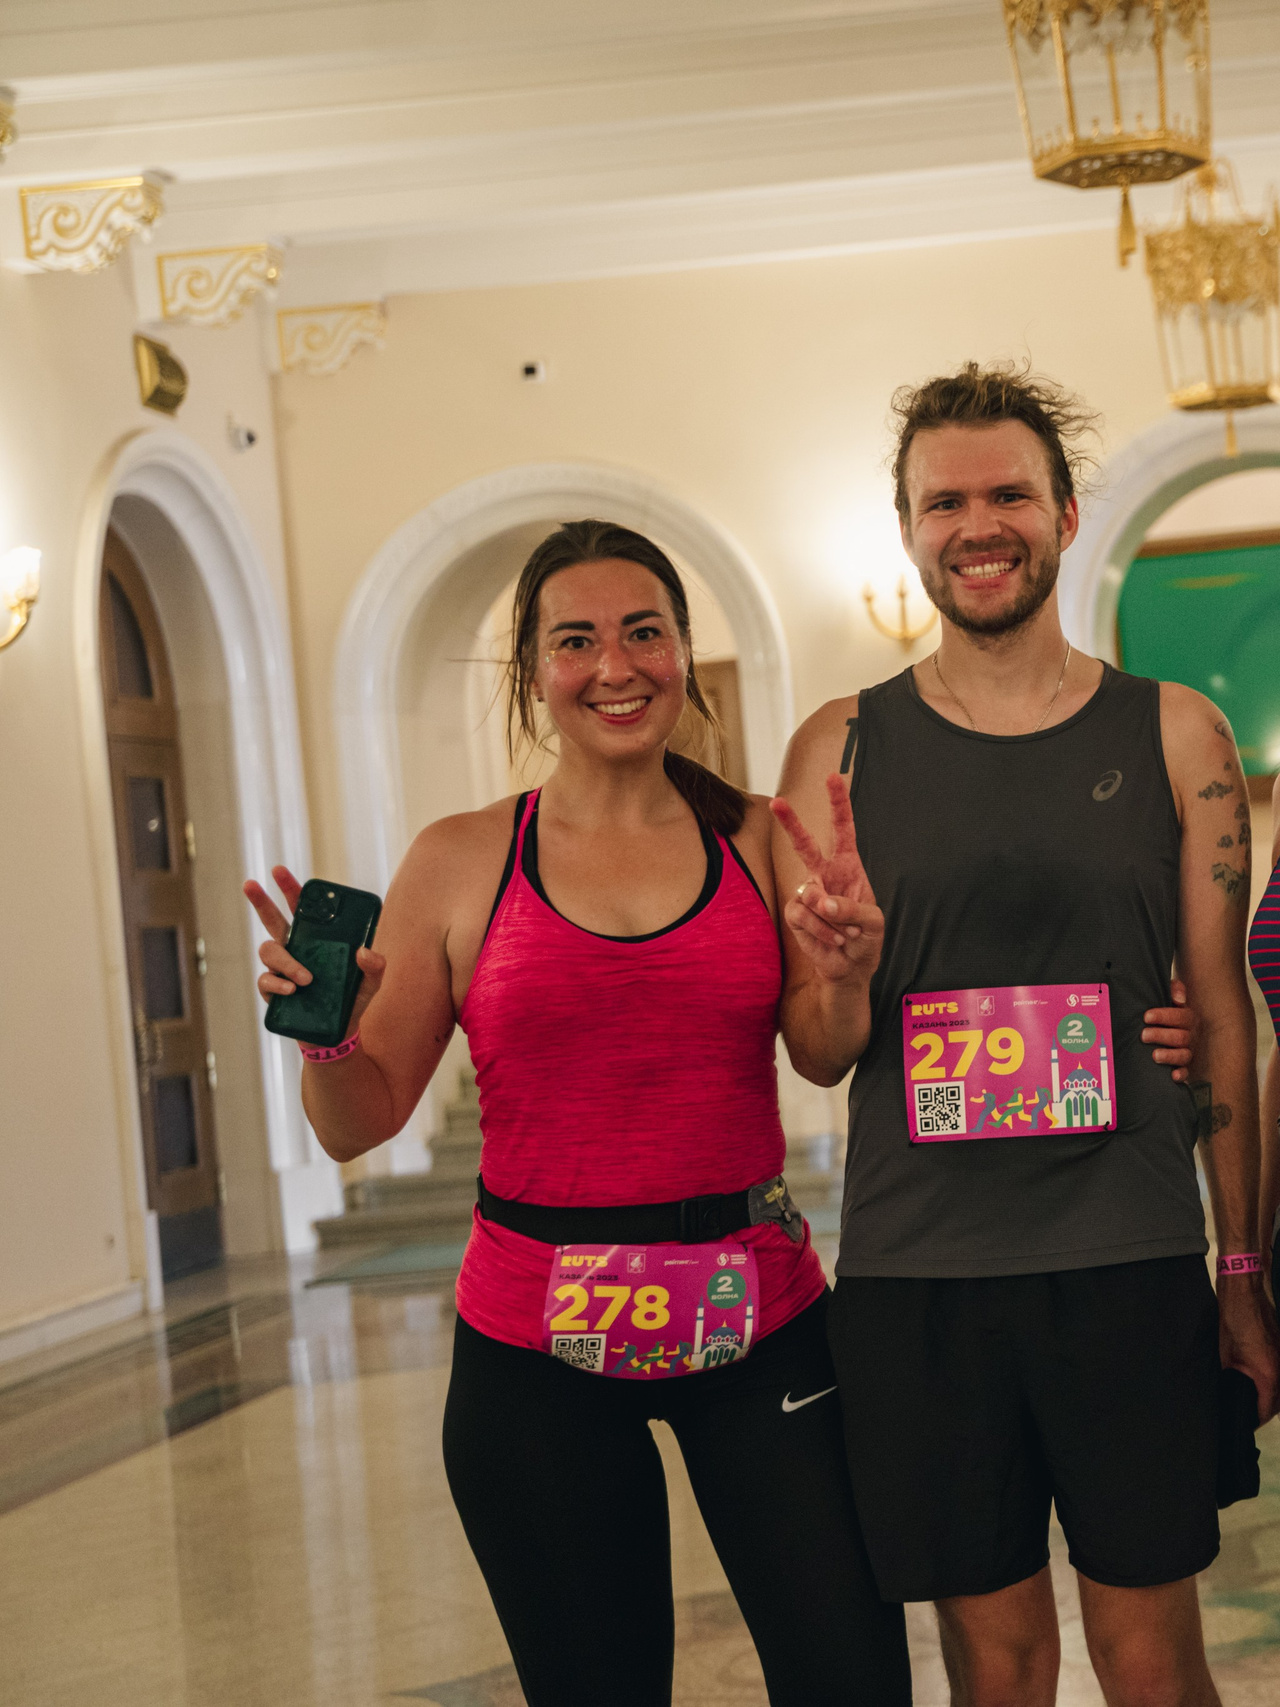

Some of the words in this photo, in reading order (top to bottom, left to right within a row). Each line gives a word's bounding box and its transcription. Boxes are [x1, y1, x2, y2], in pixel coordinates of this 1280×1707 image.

[911, 1001, 959, 1016] RUTS
[912, 1021, 948, 1029] КАЗАНЬ
[949, 1019, 970, 1027] 2023
[1067, 1020, 1083, 1036] 2
[910, 1027, 1025, 1080] 279
[560, 1255, 608, 1268] RUTS
[716, 1275, 734, 1293] 2
[550, 1284, 671, 1331] 278
